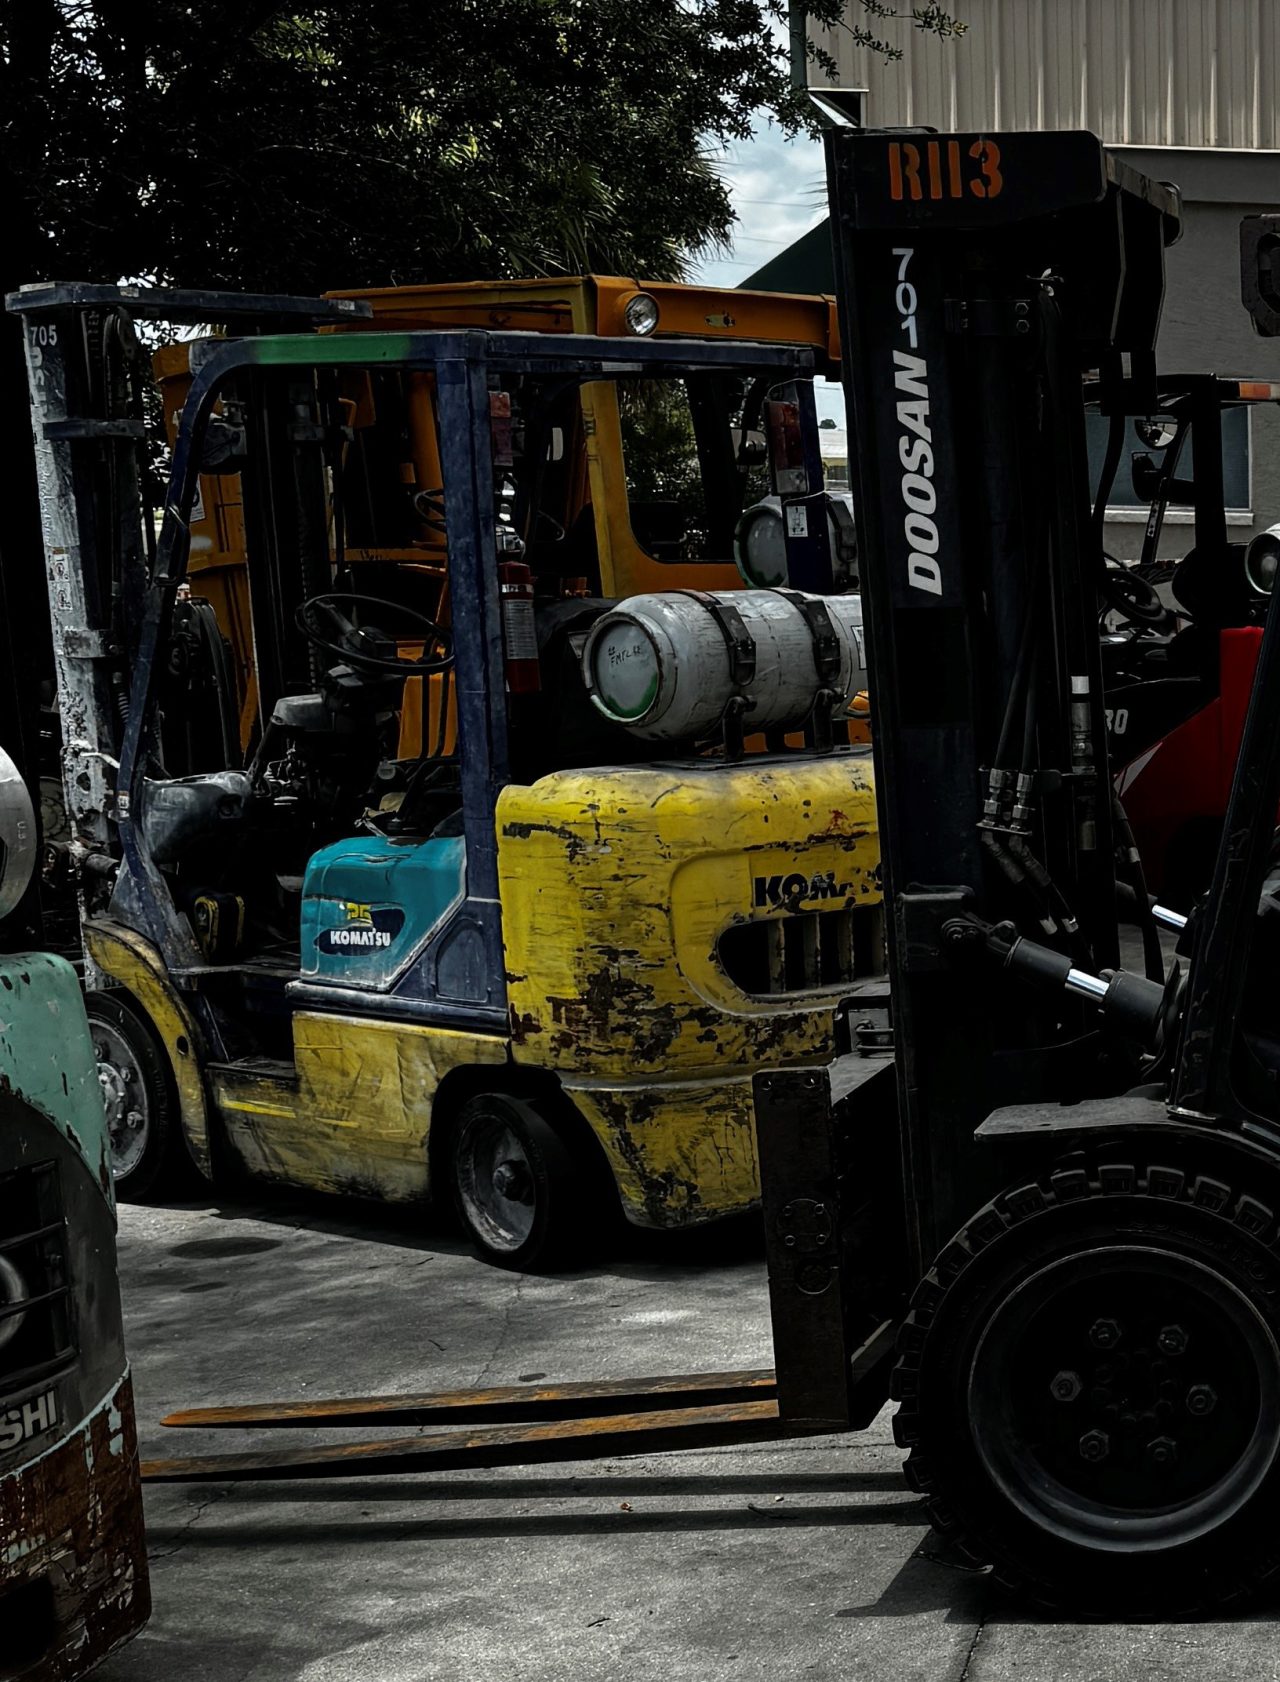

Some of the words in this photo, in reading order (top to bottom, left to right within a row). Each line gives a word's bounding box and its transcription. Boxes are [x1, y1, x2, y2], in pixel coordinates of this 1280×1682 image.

[30, 324, 58, 346] 705
[891, 349, 943, 596] DOOSAN
[330, 928, 391, 947] KOMATSU
